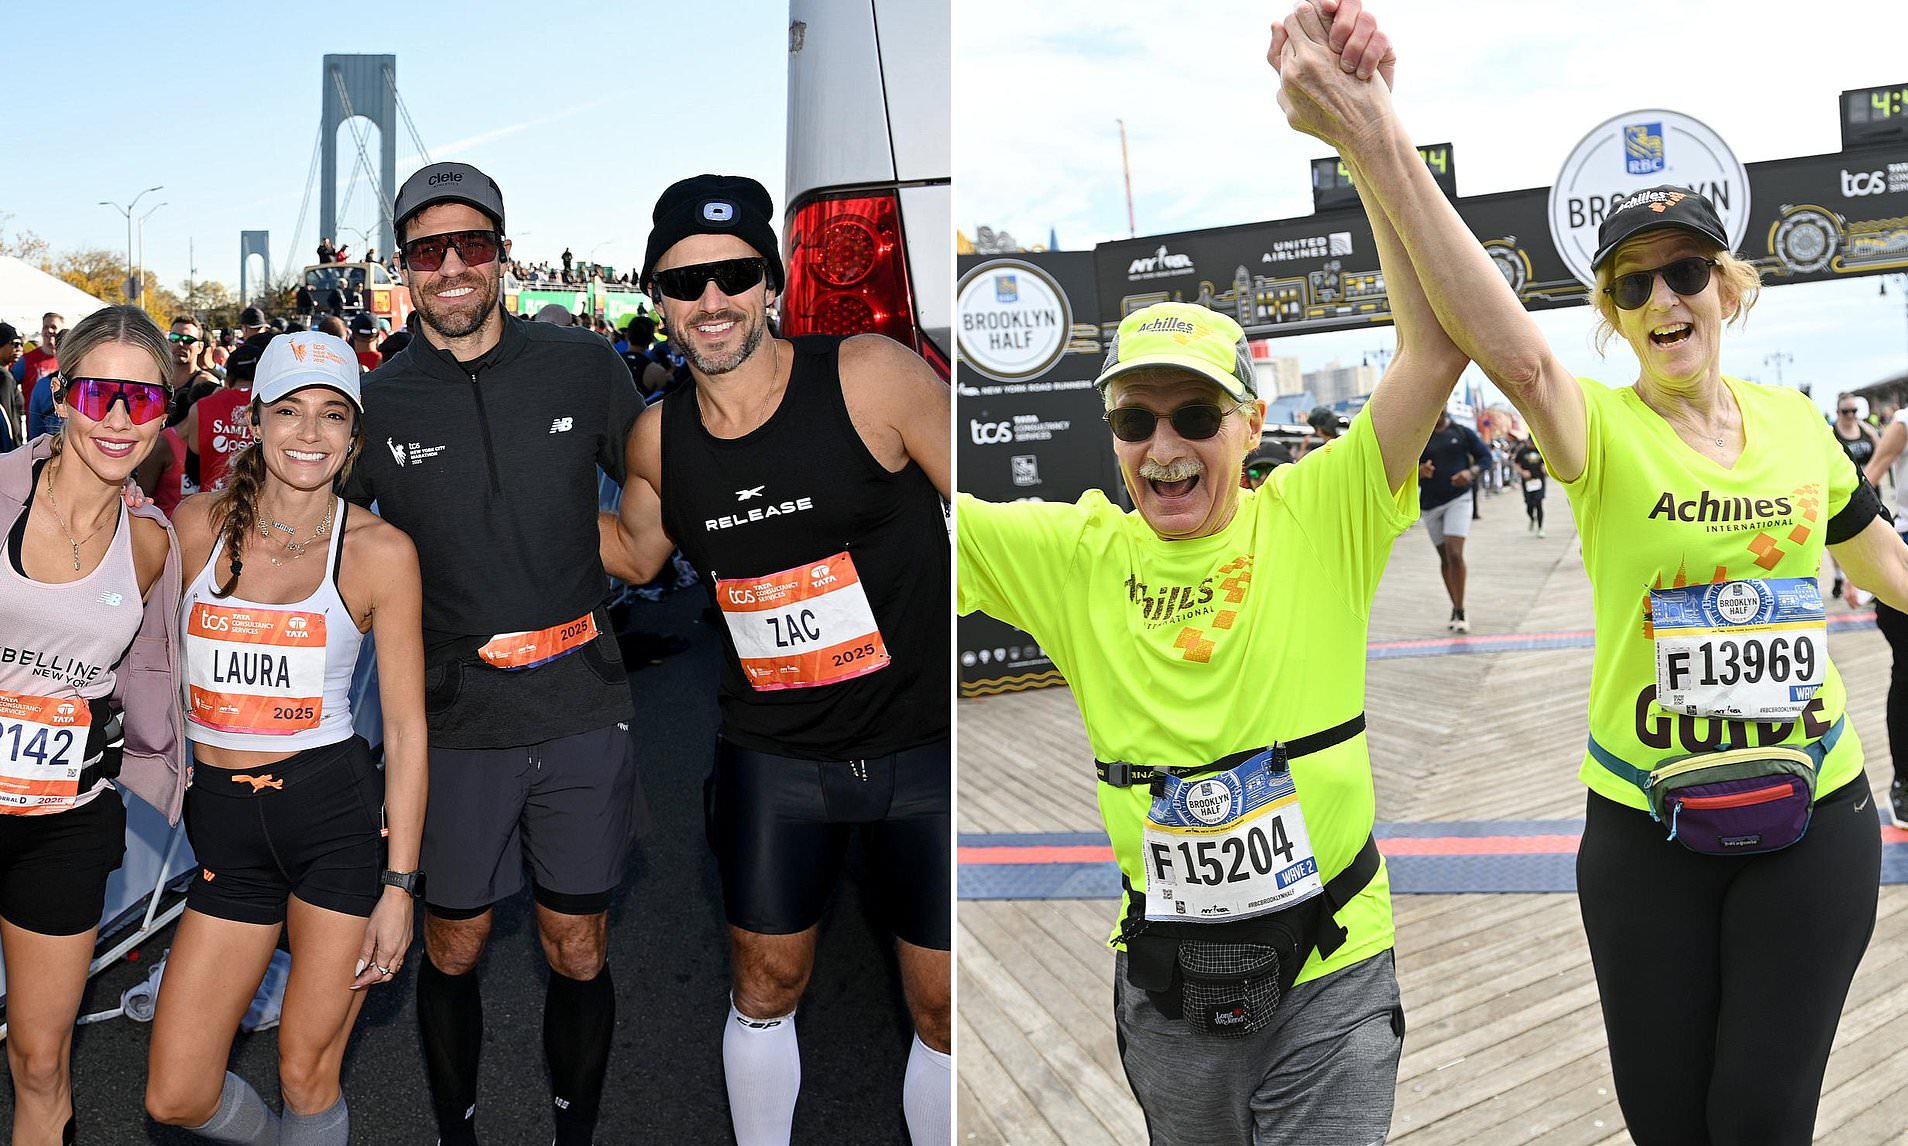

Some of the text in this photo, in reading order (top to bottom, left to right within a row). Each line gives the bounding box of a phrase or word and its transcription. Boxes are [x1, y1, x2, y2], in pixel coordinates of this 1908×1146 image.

[1628, 157, 1662, 173] RBC
[1841, 169, 1886, 198] tcs
[1273, 236, 1327, 251] UNITED
[1262, 246, 1328, 263] AIRLINES
[963, 309, 1056, 331] BROOKLYN
[1137, 317, 1194, 333] Achilles
[989, 331, 1034, 350] HALF
[970, 419, 1013, 445] tcs
[705, 497, 813, 531] RELEASE
[1648, 490, 1792, 522] Achilles
[1706, 518, 1793, 532] INTERNATIONAL
[754, 582, 772, 590] TATA
[756, 581, 799, 597] CONSULTANCY
[811, 576, 837, 587] TATA
[728, 587, 755, 604] tcs
[758, 591, 786, 602] SERVICES
[1720, 597, 1758, 608] BROOKLYN
[1729, 607, 1748, 615] HALF
[201, 609, 229, 632] tcs
[231, 620, 274, 629] CONSULTANCY
[766, 609, 820, 647] ZAC
[231, 627, 258, 635] SERVICES
[284, 630, 309, 638] TATA
[560, 620, 588, 641] 2025
[832, 643, 875, 666] 2025
[0, 647, 101, 680] BELLINE
[213, 649, 290, 688] LAURA
[1667, 652, 1690, 690] F
[1700, 637, 1815, 686] 13969
[32, 668, 63, 680] NEW
[52, 715, 75, 723] TATA
[273, 707, 314, 720] 2025
[0, 722, 73, 766] 142
[1189, 793, 1229, 808] BROOKLYN
[1201, 805, 1220, 815] HALF
[1151, 842, 1173, 880] F
[1178, 815, 1294, 886] 15204
[1282, 862, 1314, 885] WAVE 2
